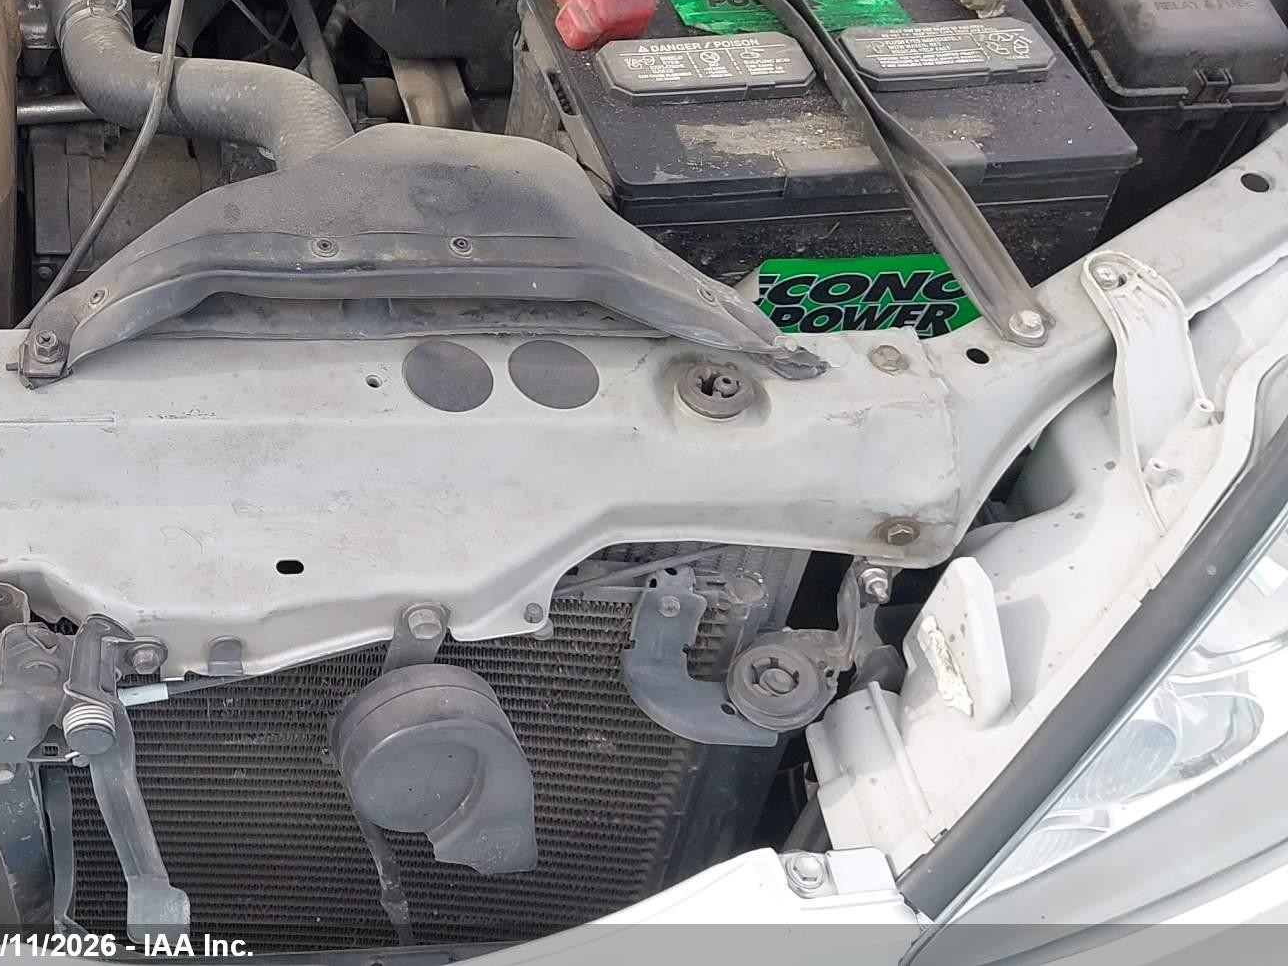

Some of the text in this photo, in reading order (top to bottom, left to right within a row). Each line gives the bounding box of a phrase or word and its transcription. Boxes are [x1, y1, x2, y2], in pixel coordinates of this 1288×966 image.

[650, 42, 702, 53] DANGER
[713, 38, 760, 48] POISON
[769, 304, 959, 340] POWER
